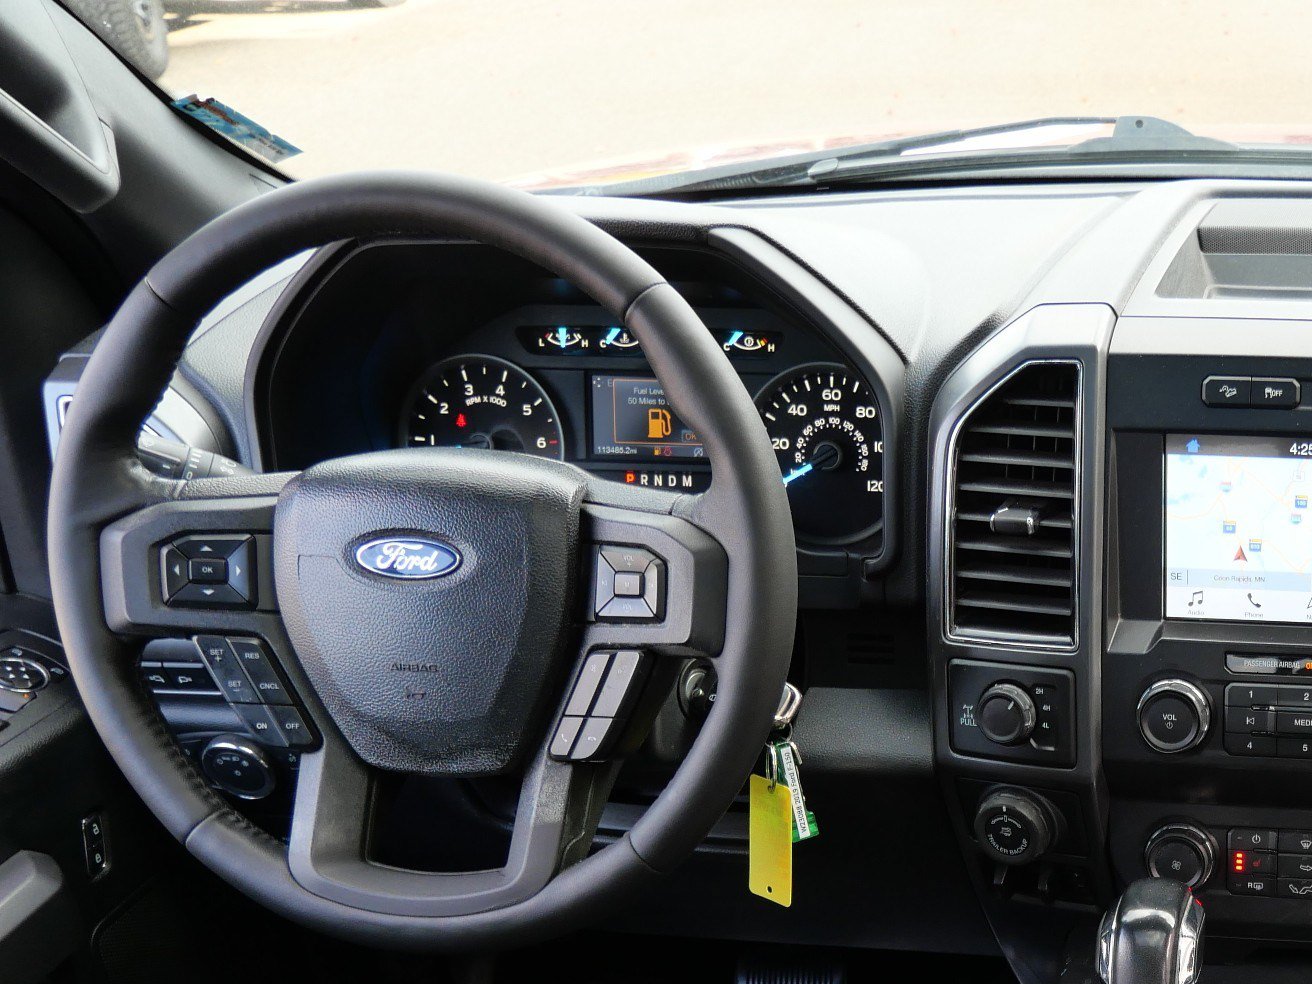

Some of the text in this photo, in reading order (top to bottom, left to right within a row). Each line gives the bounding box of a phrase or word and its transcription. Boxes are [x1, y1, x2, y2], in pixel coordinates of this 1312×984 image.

[767, 343, 775, 352] H
[464, 385, 474, 396] 3
[495, 385, 505, 396] 4
[634, 387, 665, 396] Fuel Leve
[821, 389, 842, 401] 60
[1272, 388, 1283, 398] OFF
[465, 396, 482, 407] RPM
[489, 396, 507, 408] 1000
[639, 397, 656, 405] Miles
[440, 403, 449, 415] 2
[522, 404, 532, 416] 5
[787, 404, 808, 416] 40
[823, 404, 840, 412] MPH
[855, 406, 876, 419] 80
[814, 418, 825, 427] 80
[828, 417, 840, 425] 100
[842, 420, 854, 431] 120
[803, 424, 813, 436] 60
[536, 437, 547, 449] 6
[771, 438, 790, 450] 20
[796, 437, 805, 449] 40
[626, 473, 693, 487] P R N D M
[867, 480, 883, 492] 120
[376, 541, 438, 572] Ford
[201, 566, 214, 574] OK
[1170, 572, 1182, 582] SE
[244, 652, 260, 660] RES
[1243, 659, 1279, 668] PASSENGER
[1278, 660, 1300, 669] AIRBAG
[228, 680, 242, 688] SET
[1248, 690, 1253, 699] 1
[1303, 692, 1310, 701] 2
[960, 717, 978, 727] PULL
[1162, 713, 1177, 722] VOL
[1246, 742, 1253, 750] 4
[1302, 744, 1308, 752] 5
[788, 773, 797, 788] Ford
[793, 788, 801, 805] 2019
[987, 833, 1028, 855] TRAILER BACKUP
